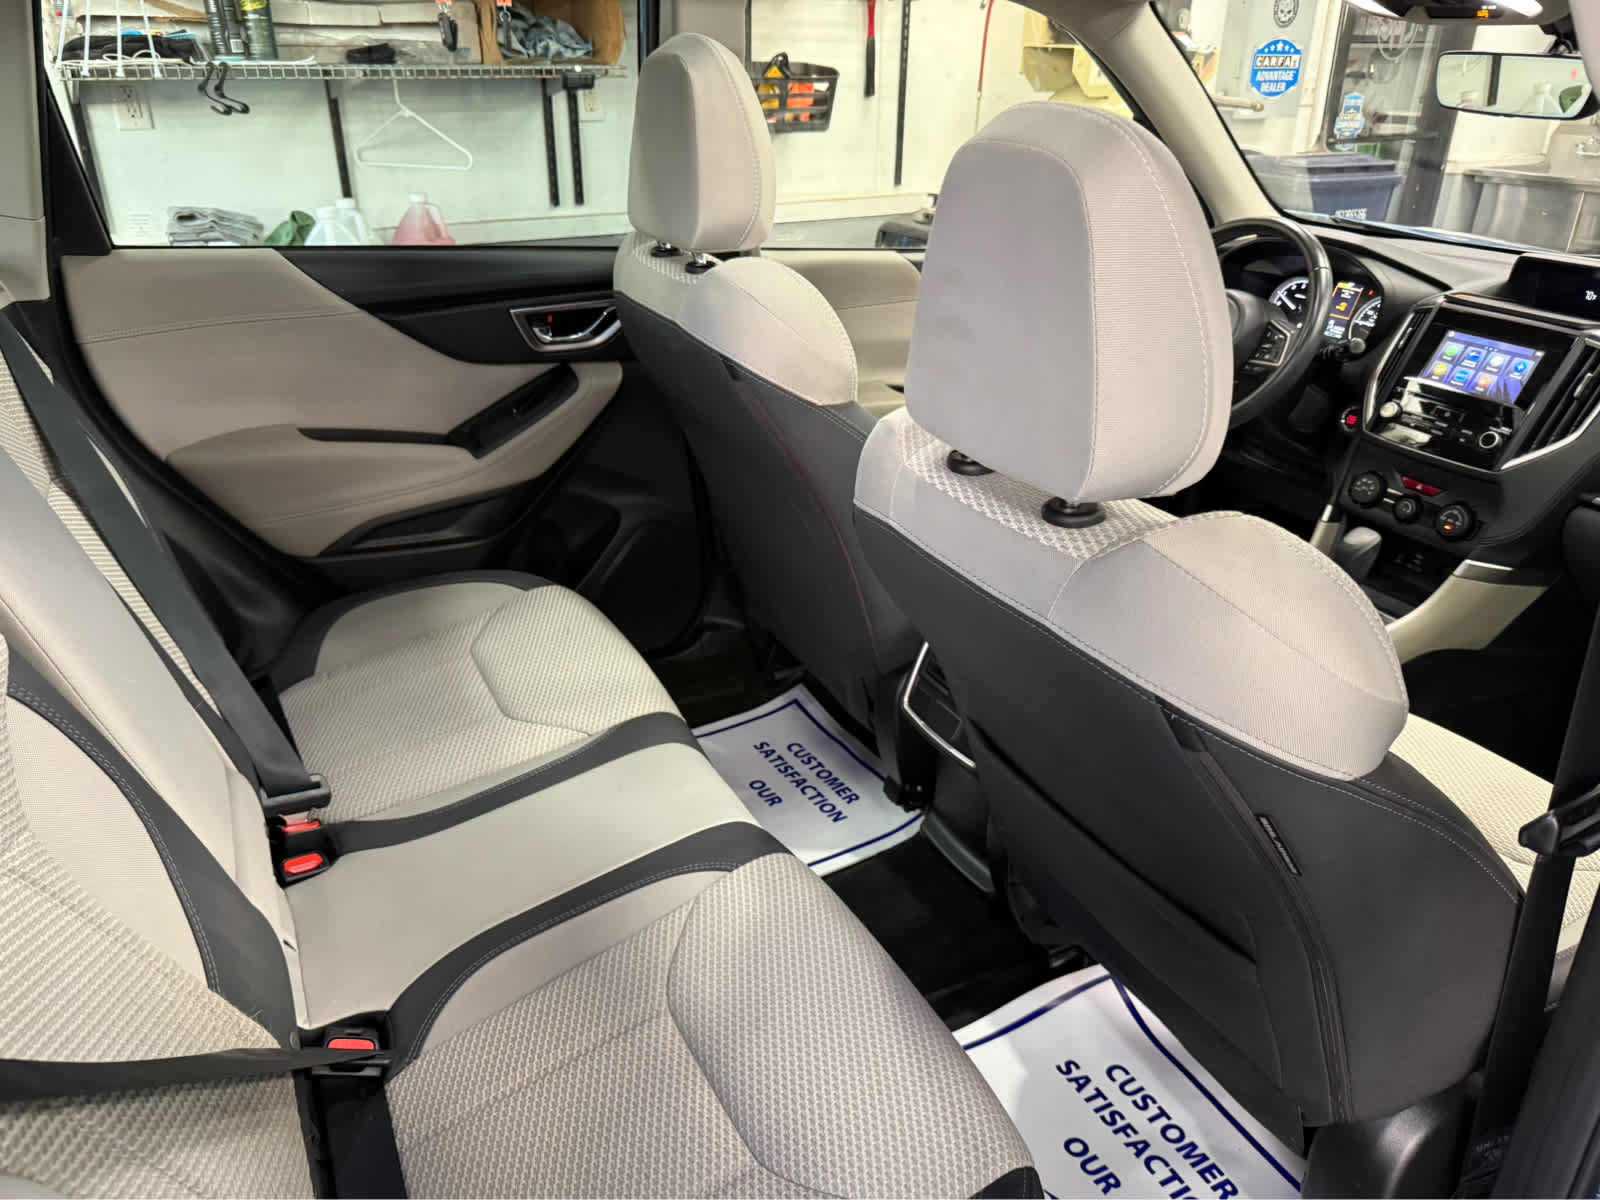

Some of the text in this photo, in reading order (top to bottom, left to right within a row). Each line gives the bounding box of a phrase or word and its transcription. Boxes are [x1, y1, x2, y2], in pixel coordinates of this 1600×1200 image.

[1260, 81, 1287, 92] DEALER
[748, 779, 783, 807] OUR
[753, 741, 848, 823] SATISFACTION
[786, 742, 860, 805] CUSTOMER
[1055, 1059, 1199, 1199] SATISFACTI
[1105, 1064, 1239, 1199] CUSTOMER
[1063, 1137, 1122, 1195] OUR
